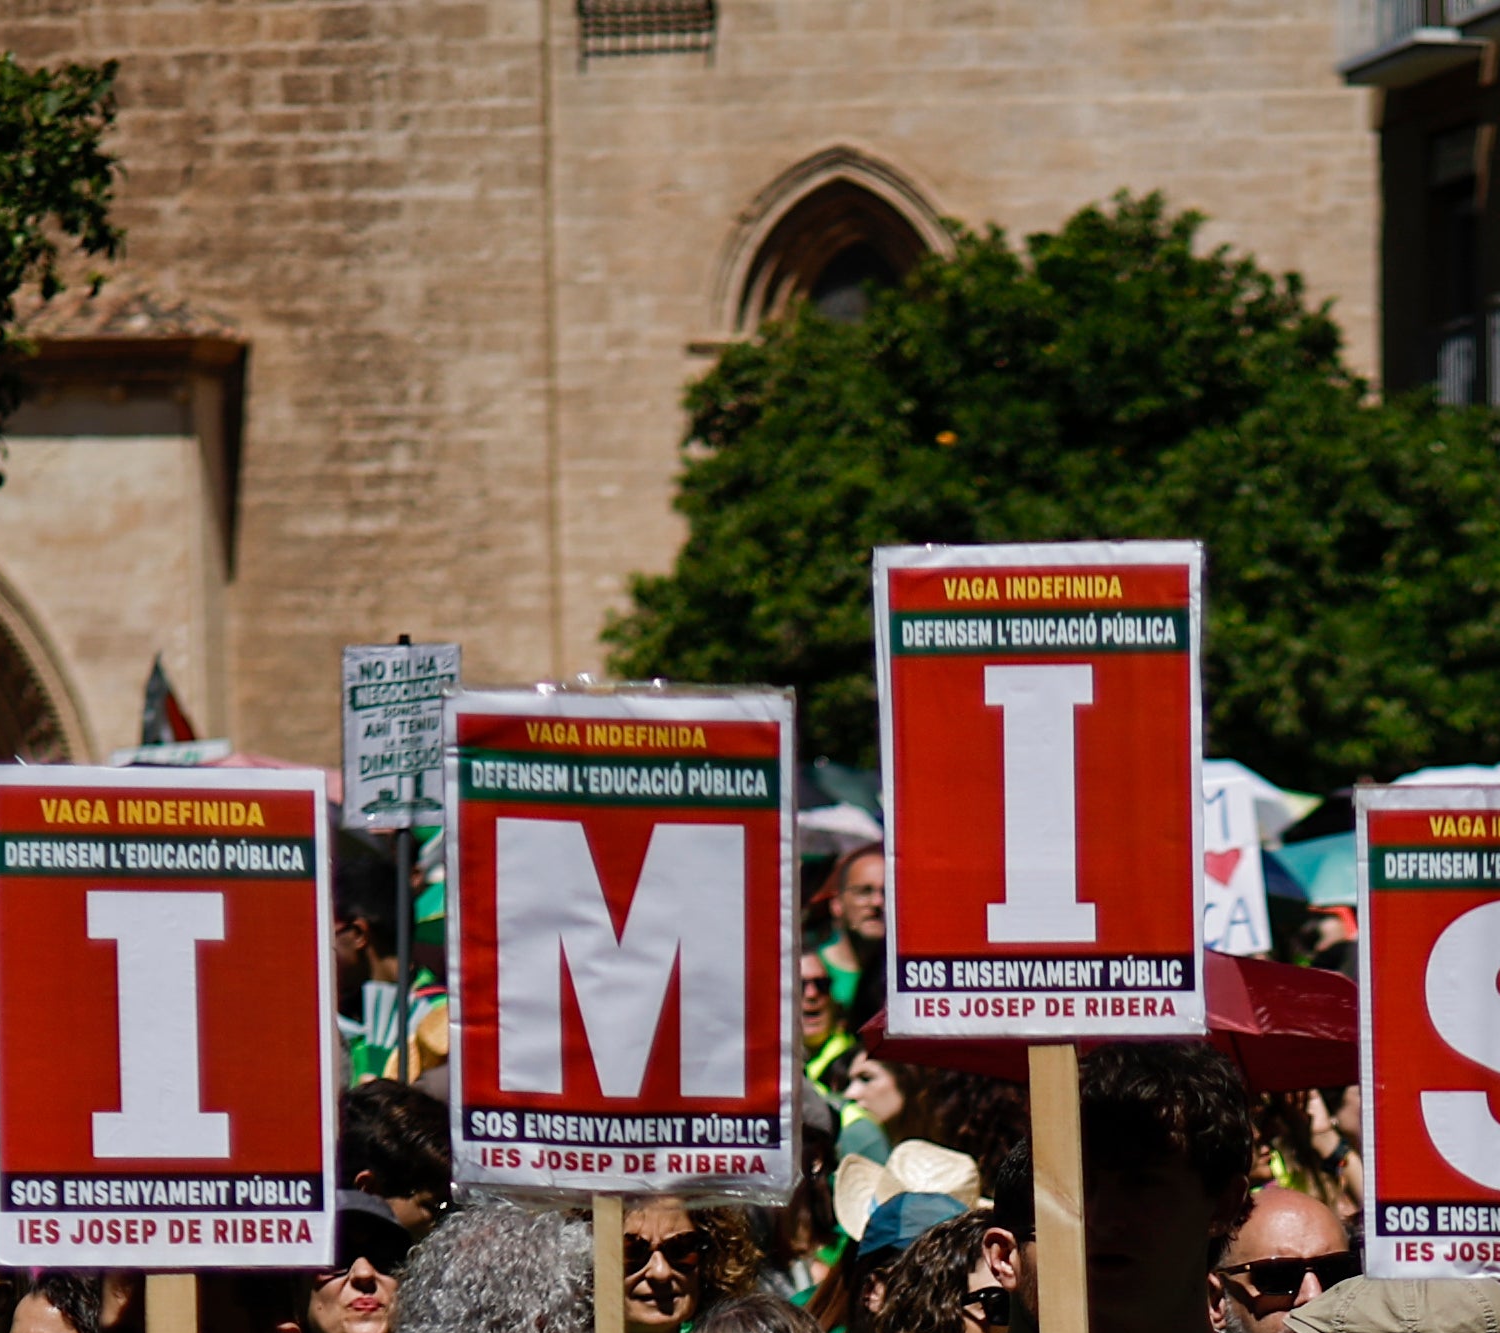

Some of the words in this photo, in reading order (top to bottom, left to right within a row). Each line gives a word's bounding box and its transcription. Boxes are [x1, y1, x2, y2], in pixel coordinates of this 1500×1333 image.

[943, 577, 999, 600] VAGA
[1005, 576, 1122, 599] INDEFINIDA
[902, 619, 992, 647] DEFENSEM
[997, 613, 1097, 645] L'EDUCACIÓ
[1101, 612, 1176, 644] PÚBLICA
[360, 661, 386, 682] NO
[393, 659, 410, 678] HI
[526, 722, 579, 744] VAGA
[586, 724, 706, 747] INDEFINIDA
[360, 739, 441, 775] DIMISSIÓ
[471, 760, 568, 791] DEFENSEM
[573, 762, 683, 795] L'EDUCACIÓ
[687, 763, 767, 796] PÚBLICA
[40, 798, 109, 824] VAGA
[118, 800, 264, 826] INDEFINIDA
[983, 664, 1096, 944] I
[1429, 816, 1485, 836] VAGA
[4, 841, 105, 867] DEFENSEM
[109, 838, 220, 869] L'EDUCACIÓ
[224, 839, 304, 870] PÚBLICA
[1384, 852, 1477, 879] DEFENSEM
[496, 817, 745, 1099] M
[905, 961, 945, 987] SOS
[952, 960, 1103, 987] ENSENYAMENT
[1109, 956, 1182, 986] PÚBLIC
[915, 998, 950, 1017] IES
[959, 998, 1035, 1017] JOSEP
[1045, 998, 1074, 1016] DE
[1085, 997, 1175, 1016] RIBERA
[86, 891, 230, 1159] I
[471, 1111, 517, 1137] SOS
[524, 1113, 685, 1142] ENSENYAMENT
[692, 1113, 769, 1144] PÚBLIC
[481, 1147, 520, 1168] IES
[530, 1149, 612, 1172] JOSEP
[624, 1153, 656, 1173] DE
[667, 1154, 767, 1178] RIBERA
[11, 1180, 57, 1205] SOS
[63, 1180, 229, 1205] ENSENYAMENT
[235, 1175, 311, 1204] PÚBLIC
[19, 1219, 59, 1244] IES
[70, 1219, 156, 1244] JOSEP
[169, 1219, 201, 1243] DE
[214, 1219, 311, 1243] RIBERA
[1385, 1206, 1429, 1231] SOS
[1395, 1242, 1434, 1261] IES
